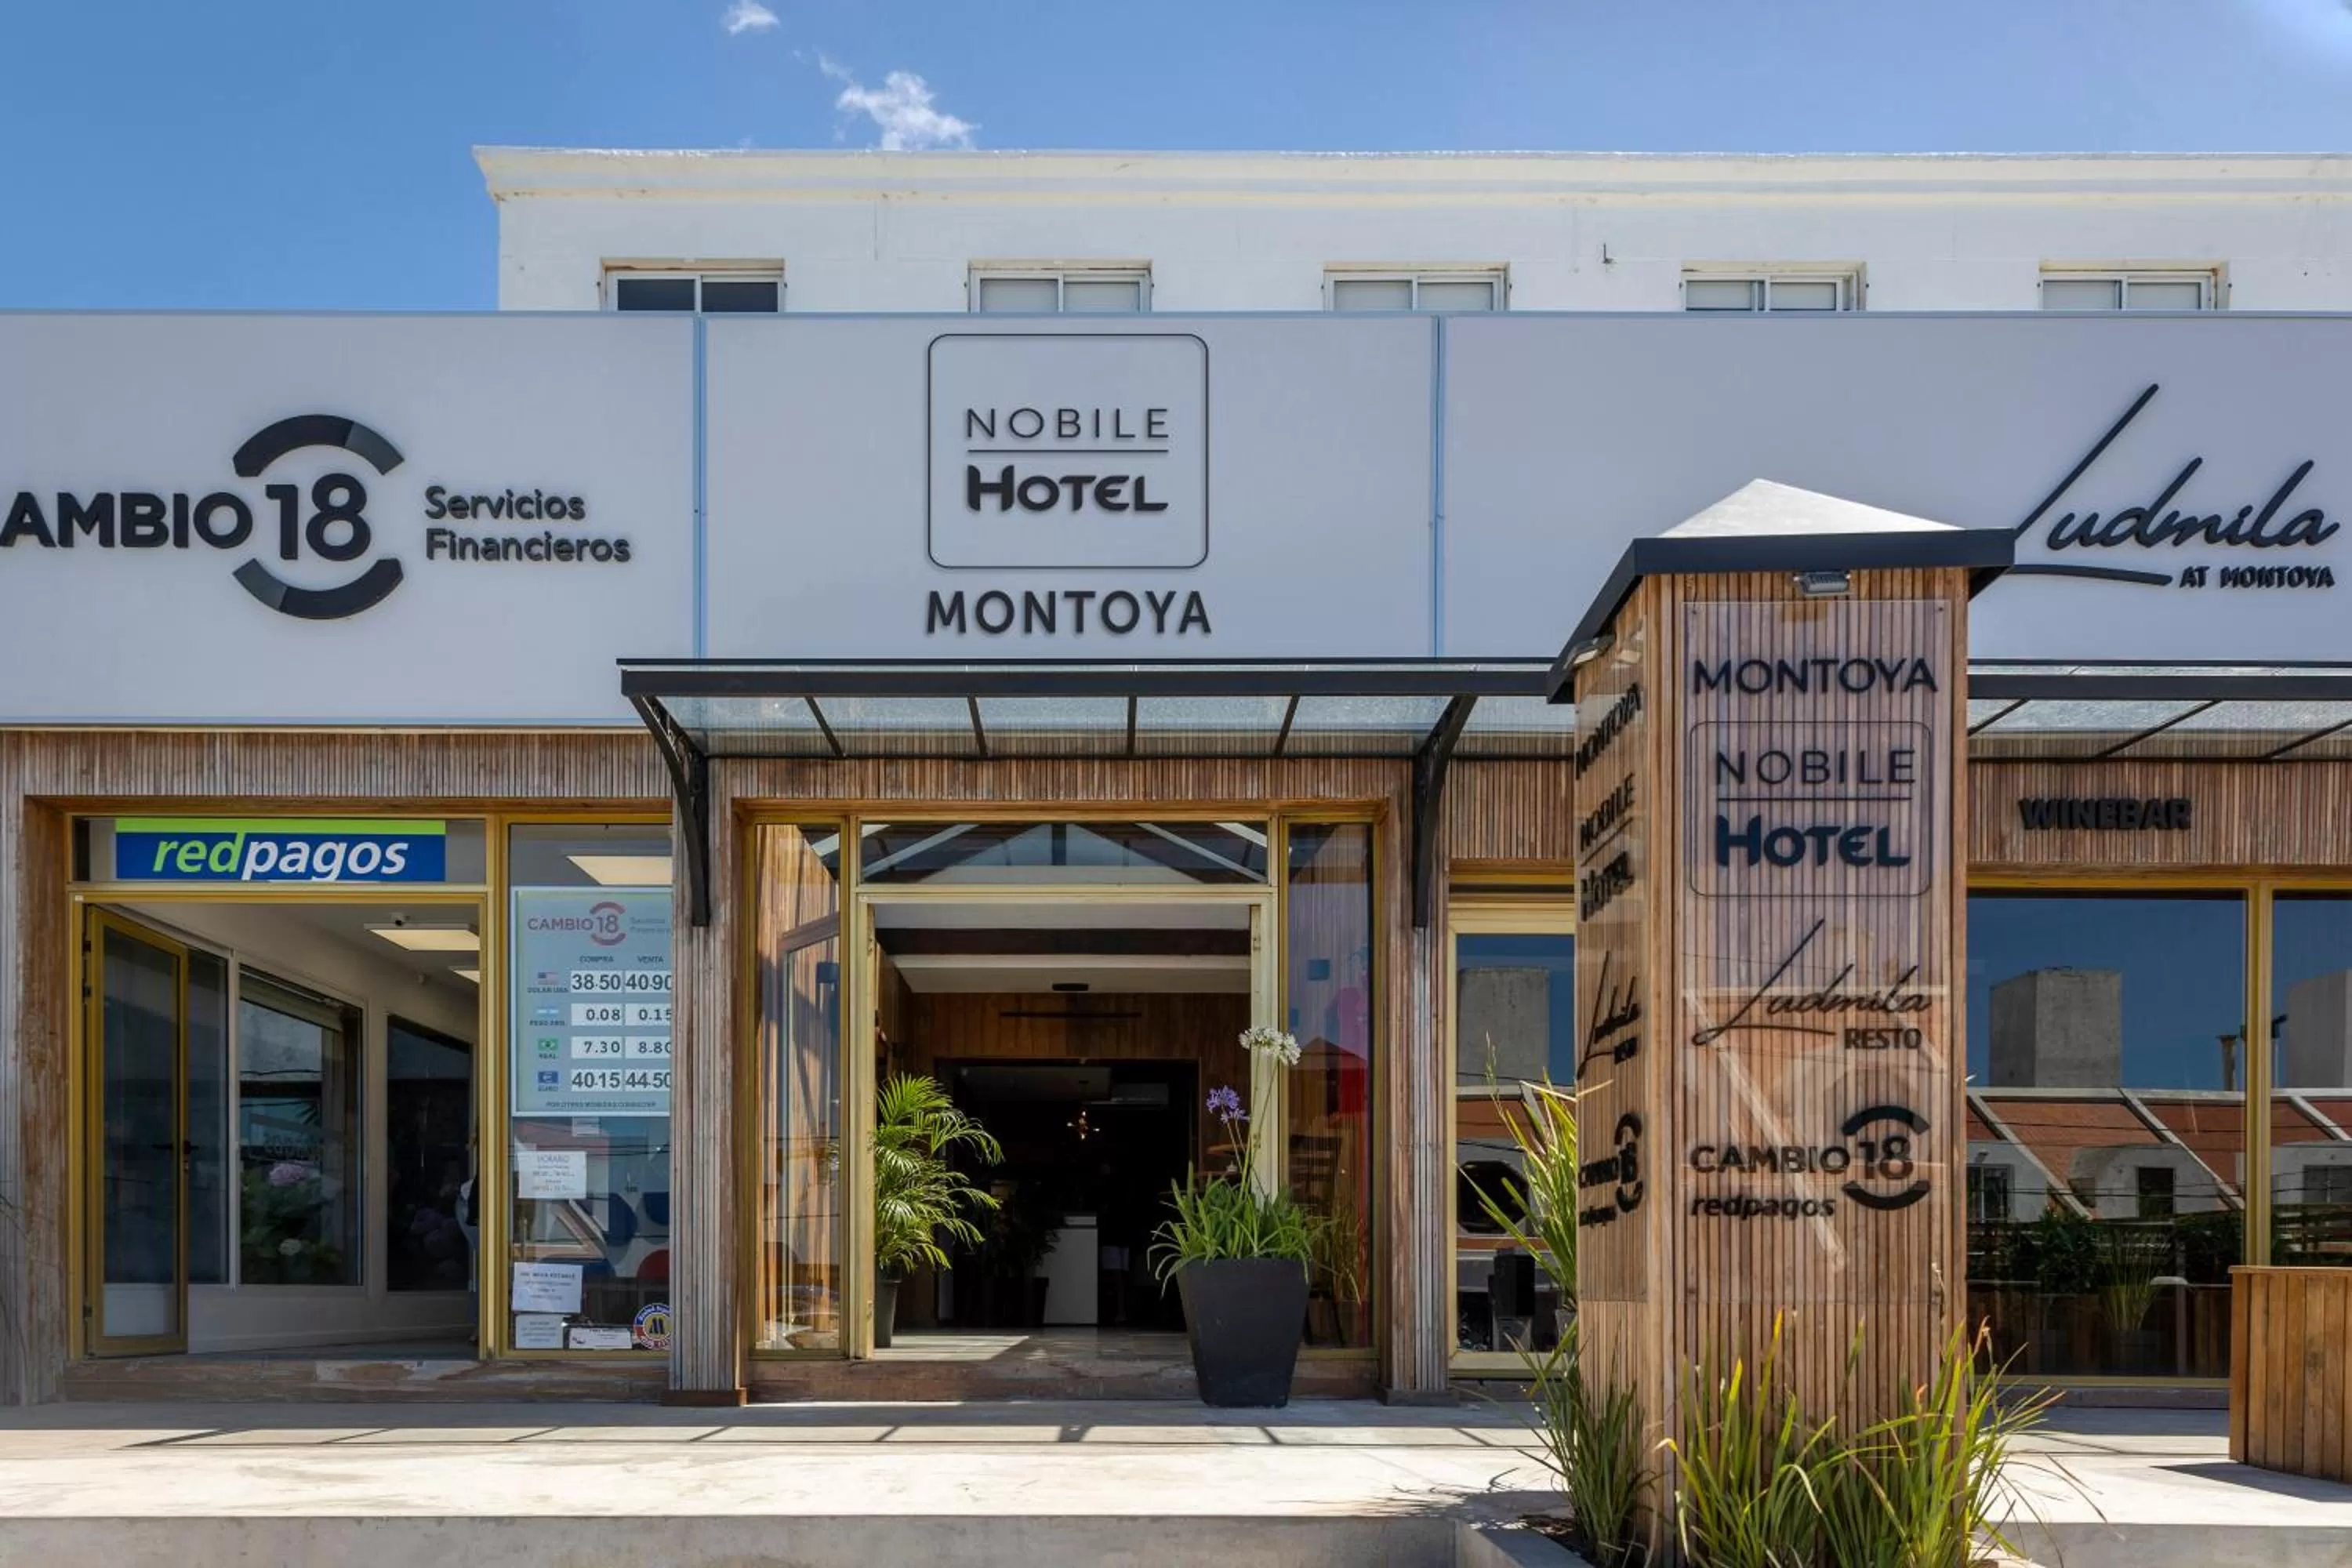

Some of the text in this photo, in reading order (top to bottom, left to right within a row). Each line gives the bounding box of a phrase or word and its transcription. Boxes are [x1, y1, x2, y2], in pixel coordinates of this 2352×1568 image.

[966, 408, 1169, 439] NOBILE
[967, 464, 1169, 512] HOTEL
[2005, 383, 2340, 586] Ludmila
[0, 473, 372, 562] AMBIO 18
[424, 486, 585, 521] Servicios
[425, 528, 630, 562] Financieros
[2180, 564, 2336, 588] AT MONTOYA
[927, 590, 1211, 634] MONTOYA
[1693, 658, 1937, 694] MONTOYA
[1717, 750, 1915, 785] NOBILE
[2019, 798, 2192, 829] WINEBAR
[152, 831, 408, 881] redpagos
[1715, 815, 1911, 867] HOTEL
[528, 918, 593, 931] CAMBIO
[596, 915, 619, 933] 18
[572, 974, 621, 990] 38.50
[1691, 919, 1933, 1047] Ludmila
[586, 1009, 620, 1021] 0.08
[583, 1041, 620, 1053] 7.30
[1844, 1028, 1922, 1049] RESTO
[1690, 1136, 1915, 1180] CAMBIO 18
[1691, 1193, 1837, 1221] redpagos
